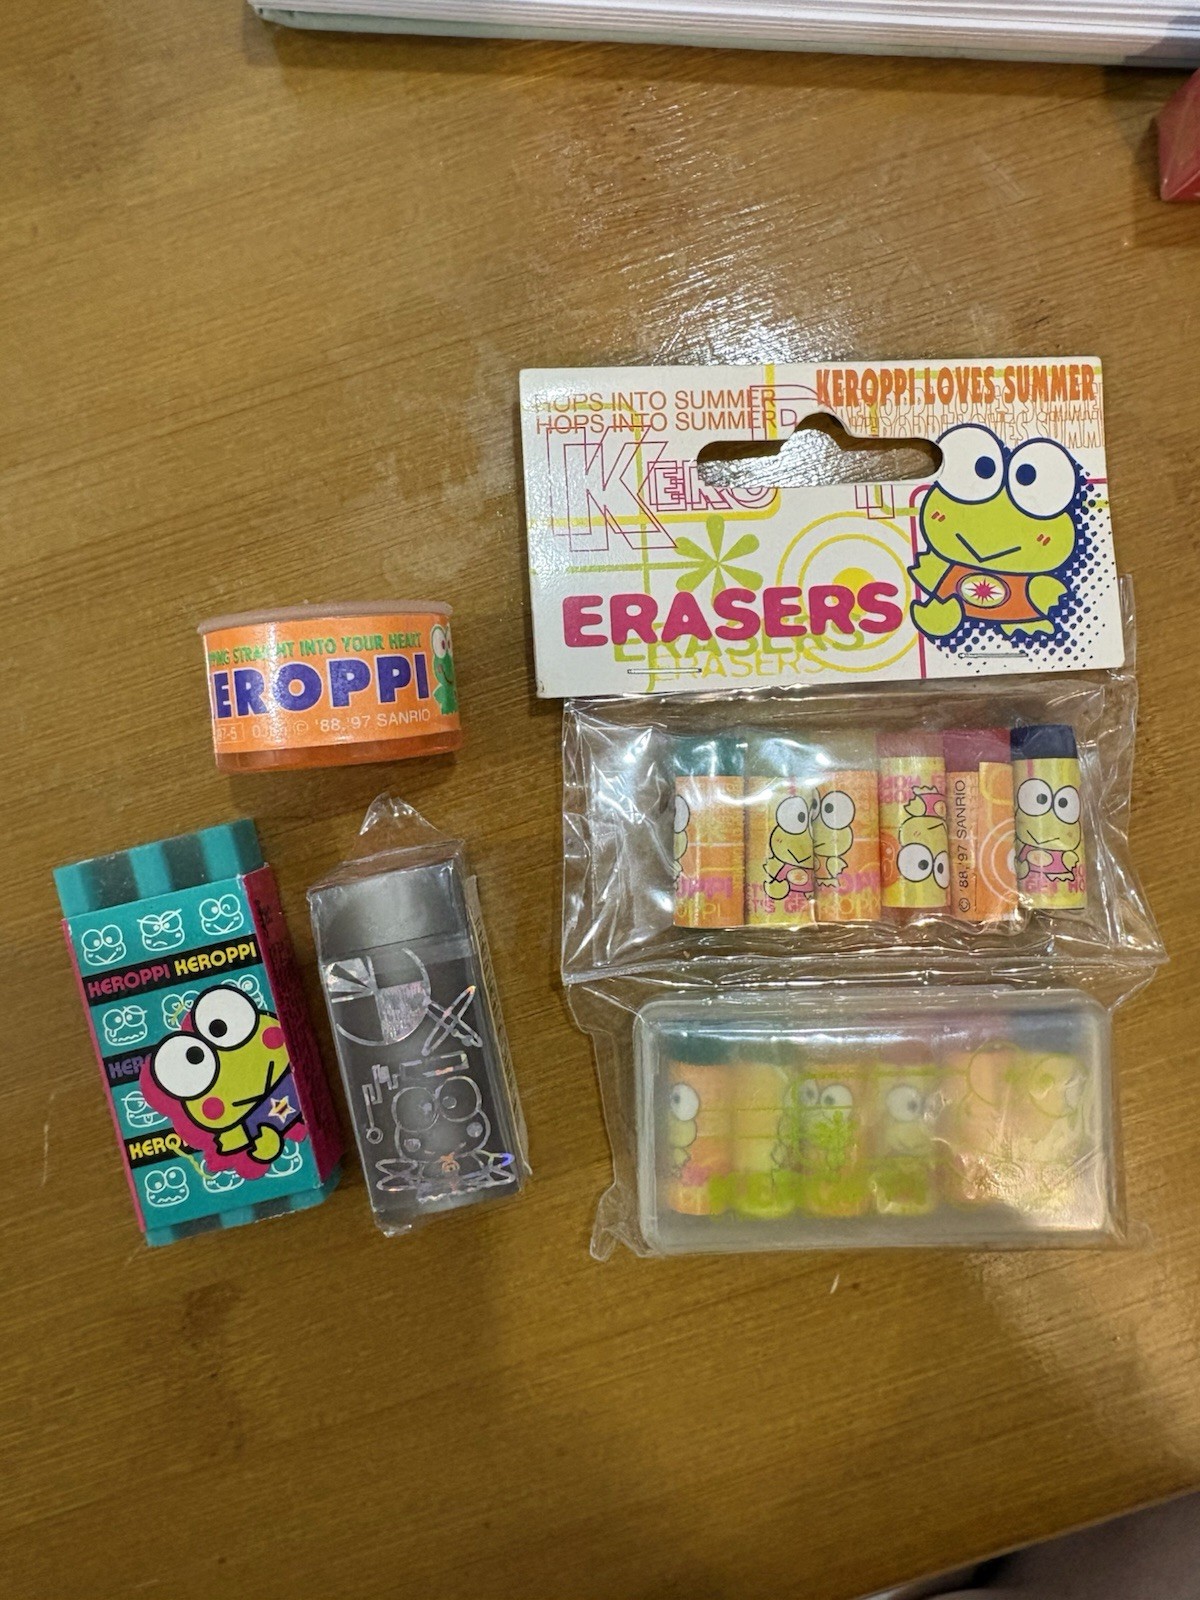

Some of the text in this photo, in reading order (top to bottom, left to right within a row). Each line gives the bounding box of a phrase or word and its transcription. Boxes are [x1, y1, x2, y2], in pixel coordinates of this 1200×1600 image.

[611, 391, 668, 412] INTO
[674, 389, 777, 411] SUMMER
[816, 368, 915, 407] KEROPPI
[924, 366, 995, 406] LOVES
[1004, 364, 1096, 404] SUMMER
[536, 409, 777, 435] HOPS INTO SUMMER
[562, 581, 904, 648] ERASERS
[232, 641, 295, 665] STRAIHT
[299, 637, 337, 657] INTO
[341, 633, 386, 653] YOUR
[388, 631, 422, 650] HEART
[376, 708, 432, 728] SANRIO
[954, 779, 968, 840] SANRIO
[173, 940, 258, 978] KEROPPI
